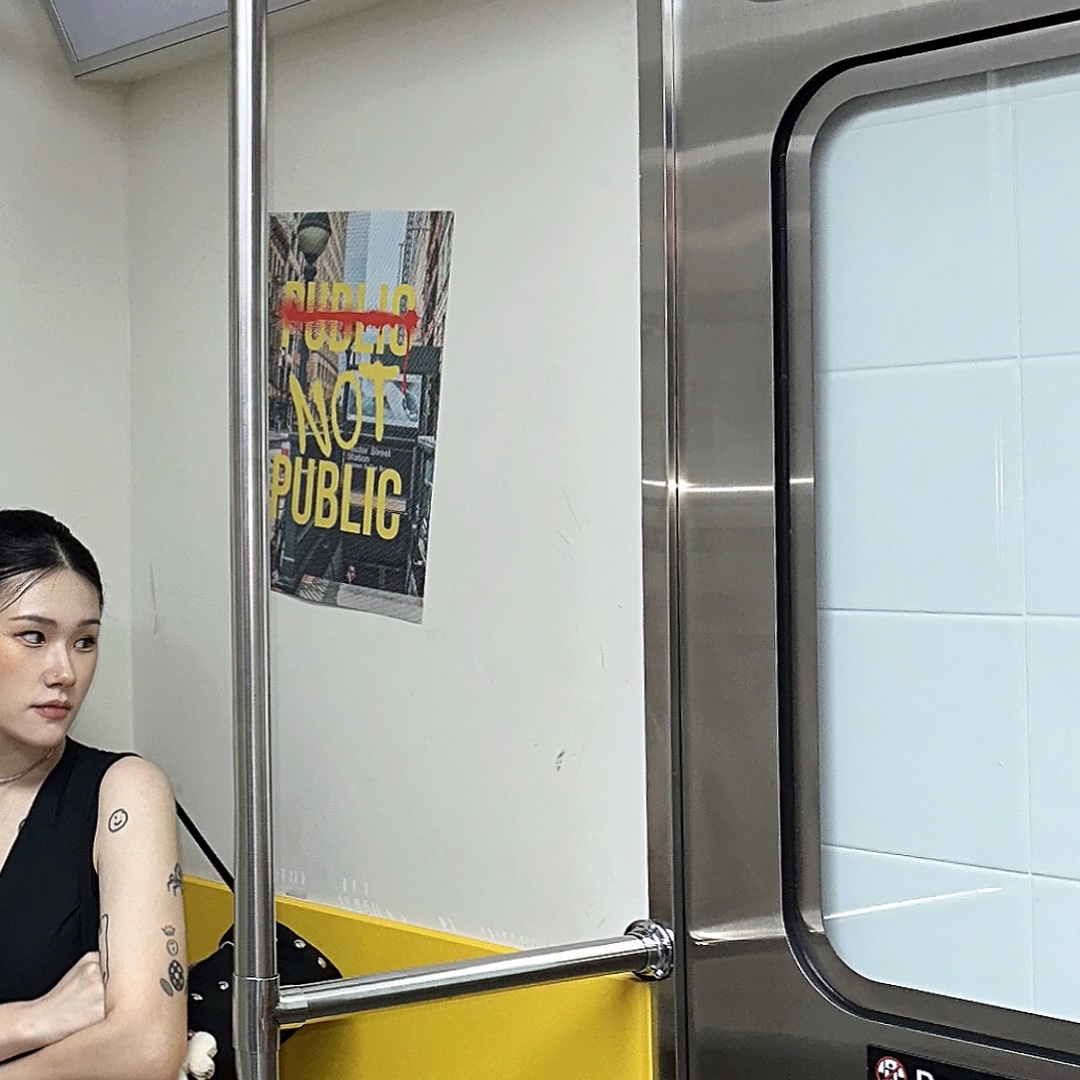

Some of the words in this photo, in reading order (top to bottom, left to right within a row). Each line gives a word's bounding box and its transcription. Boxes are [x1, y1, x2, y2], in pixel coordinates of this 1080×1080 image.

[282, 281, 417, 357] PUBLIC
[288, 361, 400, 457] NOT
[346, 452, 370, 463] Station
[370, 446, 391, 458] Street
[270, 456, 402, 541] PUBLIC
